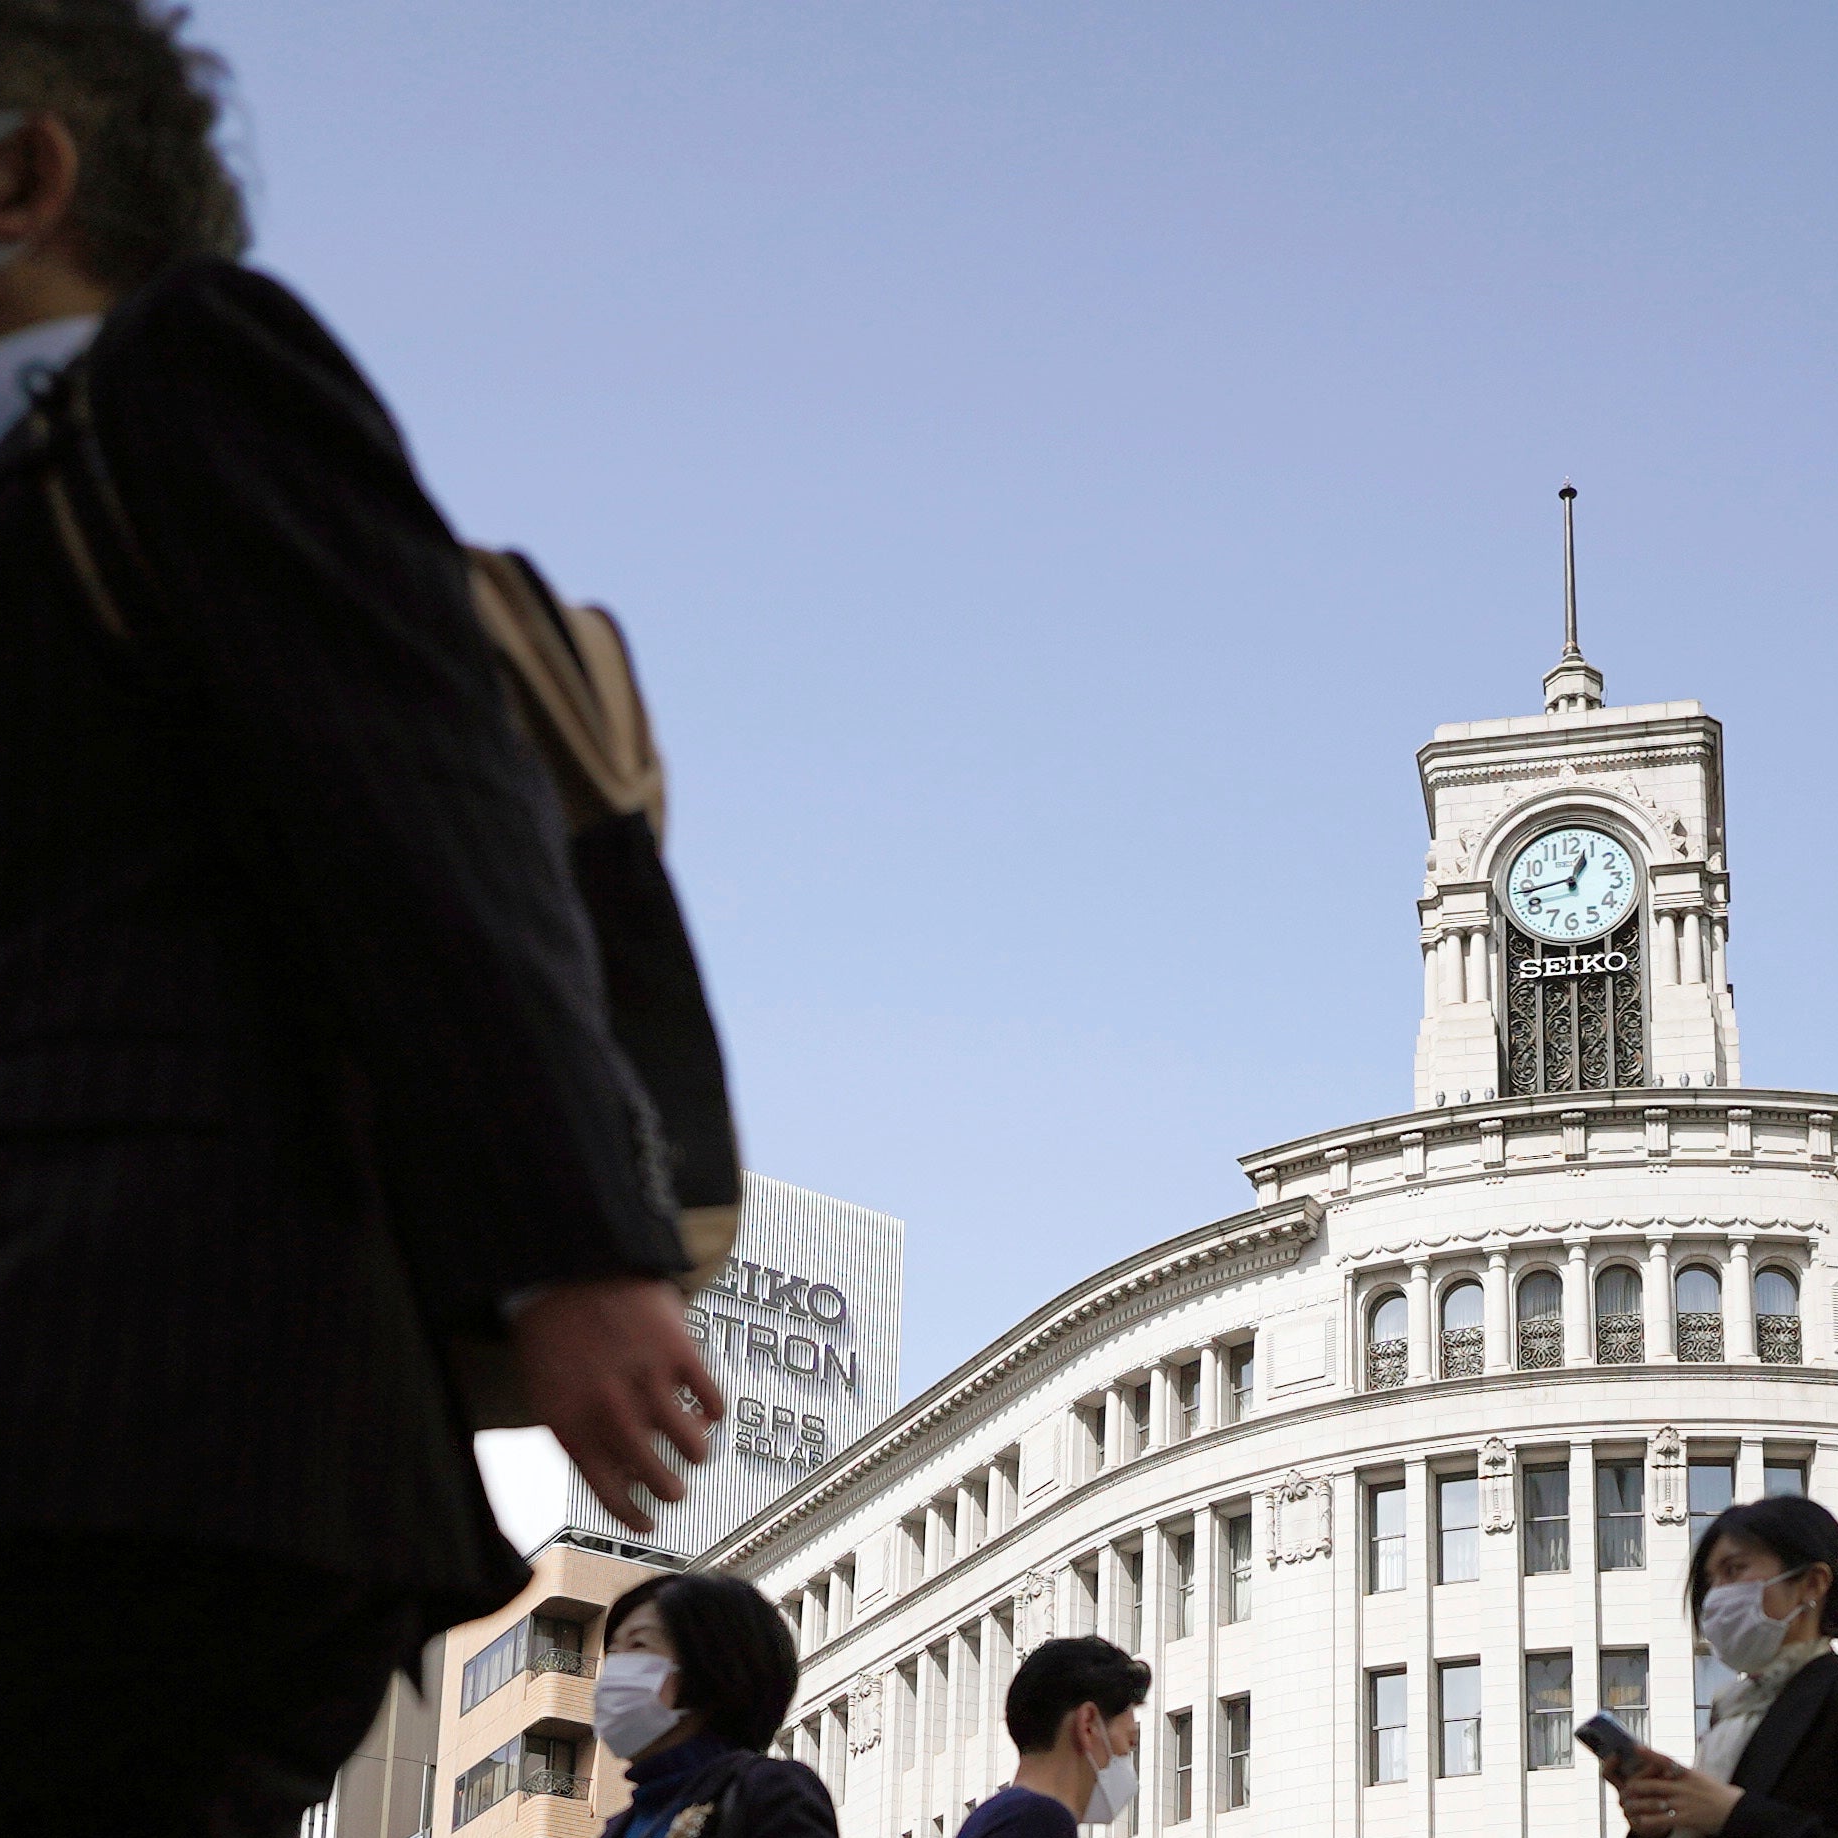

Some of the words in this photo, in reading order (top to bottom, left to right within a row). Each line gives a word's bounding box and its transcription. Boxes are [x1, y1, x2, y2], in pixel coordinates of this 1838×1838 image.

[1543, 843, 1557, 861] 11
[1562, 837, 1581, 855] 12
[1589, 841, 1595, 857] 1
[1526, 860, 1543, 877] 10
[1602, 852, 1616, 870] 2
[1609, 871, 1624, 889] 3
[1527, 897, 1542, 915] 8
[1601, 891, 1618, 908] 4
[1546, 909, 1560, 927] 7
[1564, 912, 1579, 931] 6
[1586, 906, 1600, 924] 5
[1519, 951, 1628, 979] SEIKO
[707, 1257, 847, 1325] EIKO
[682, 1305, 856, 1392] STRON
[736, 1397, 825, 1446] GPS
